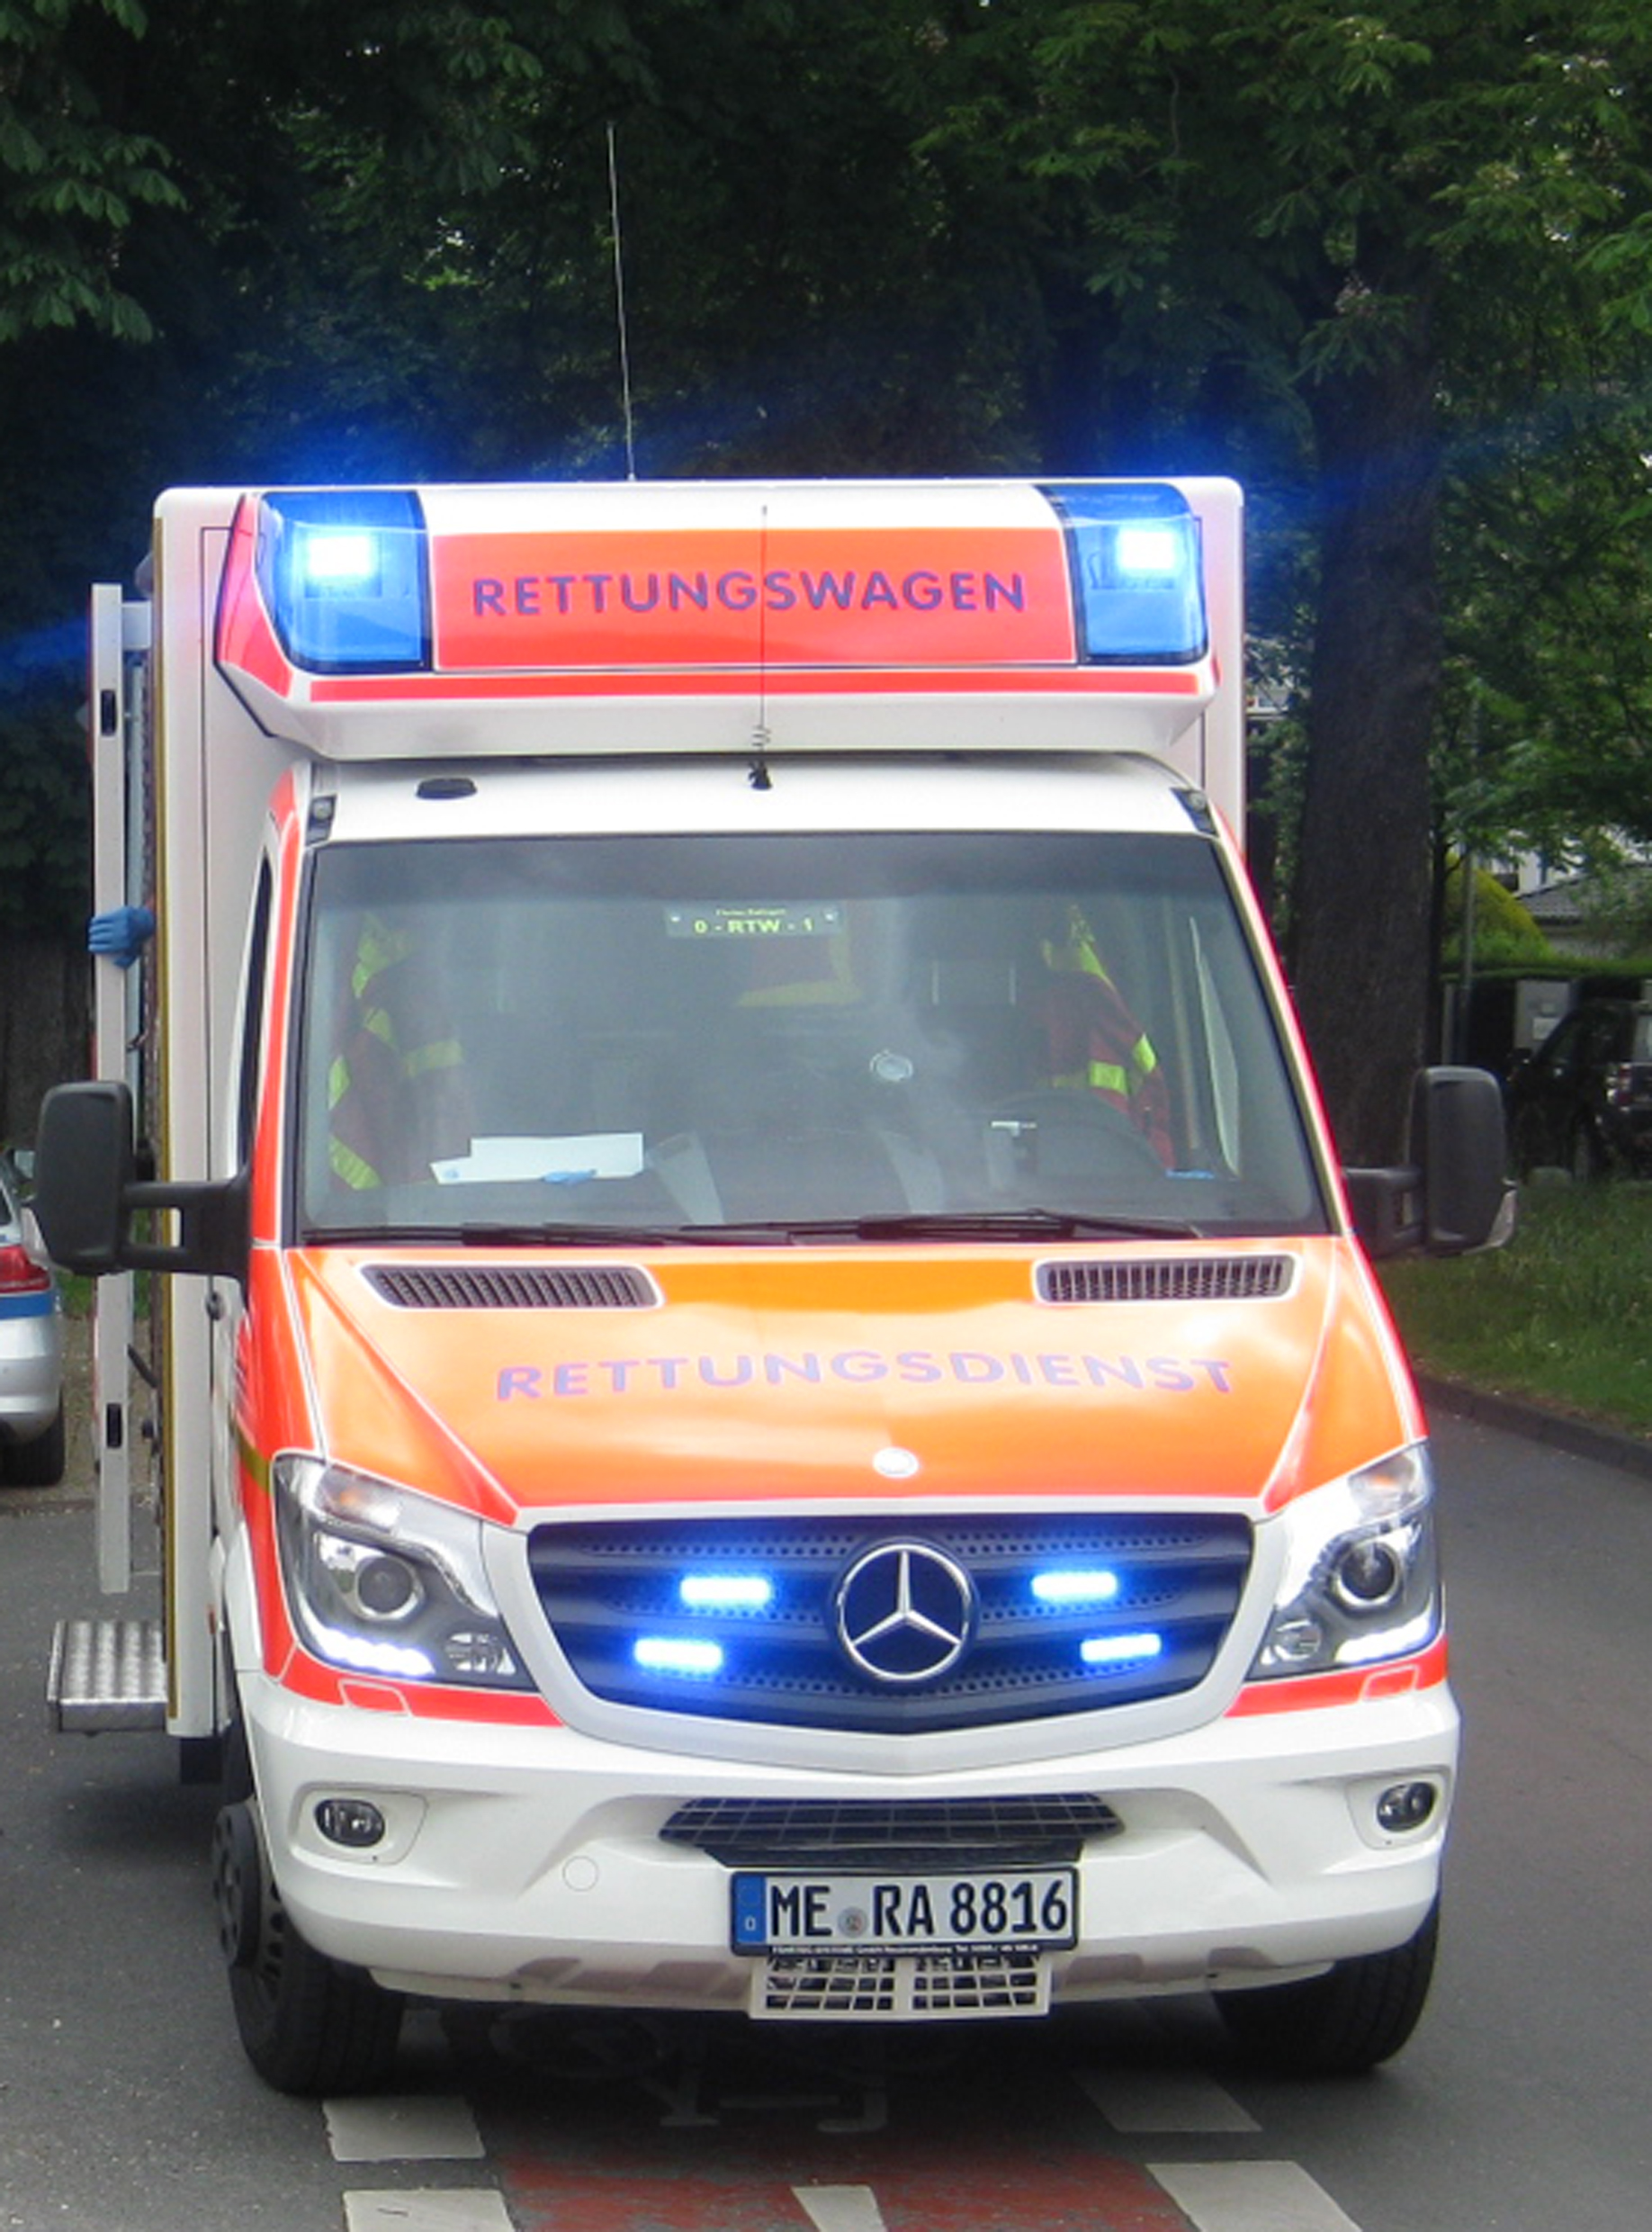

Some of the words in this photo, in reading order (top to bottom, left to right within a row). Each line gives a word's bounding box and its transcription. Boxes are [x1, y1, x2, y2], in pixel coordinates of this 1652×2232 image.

[472, 570, 1026, 616] RETTUNGSWAGEN
[727, 918, 781, 933] RTW
[496, 1349, 1233, 1400] RETTUNGSDIENST
[771, 1885, 832, 1937] ME
[873, 1884, 935, 1936] RA
[950, 1879, 1068, 1935] 8816
